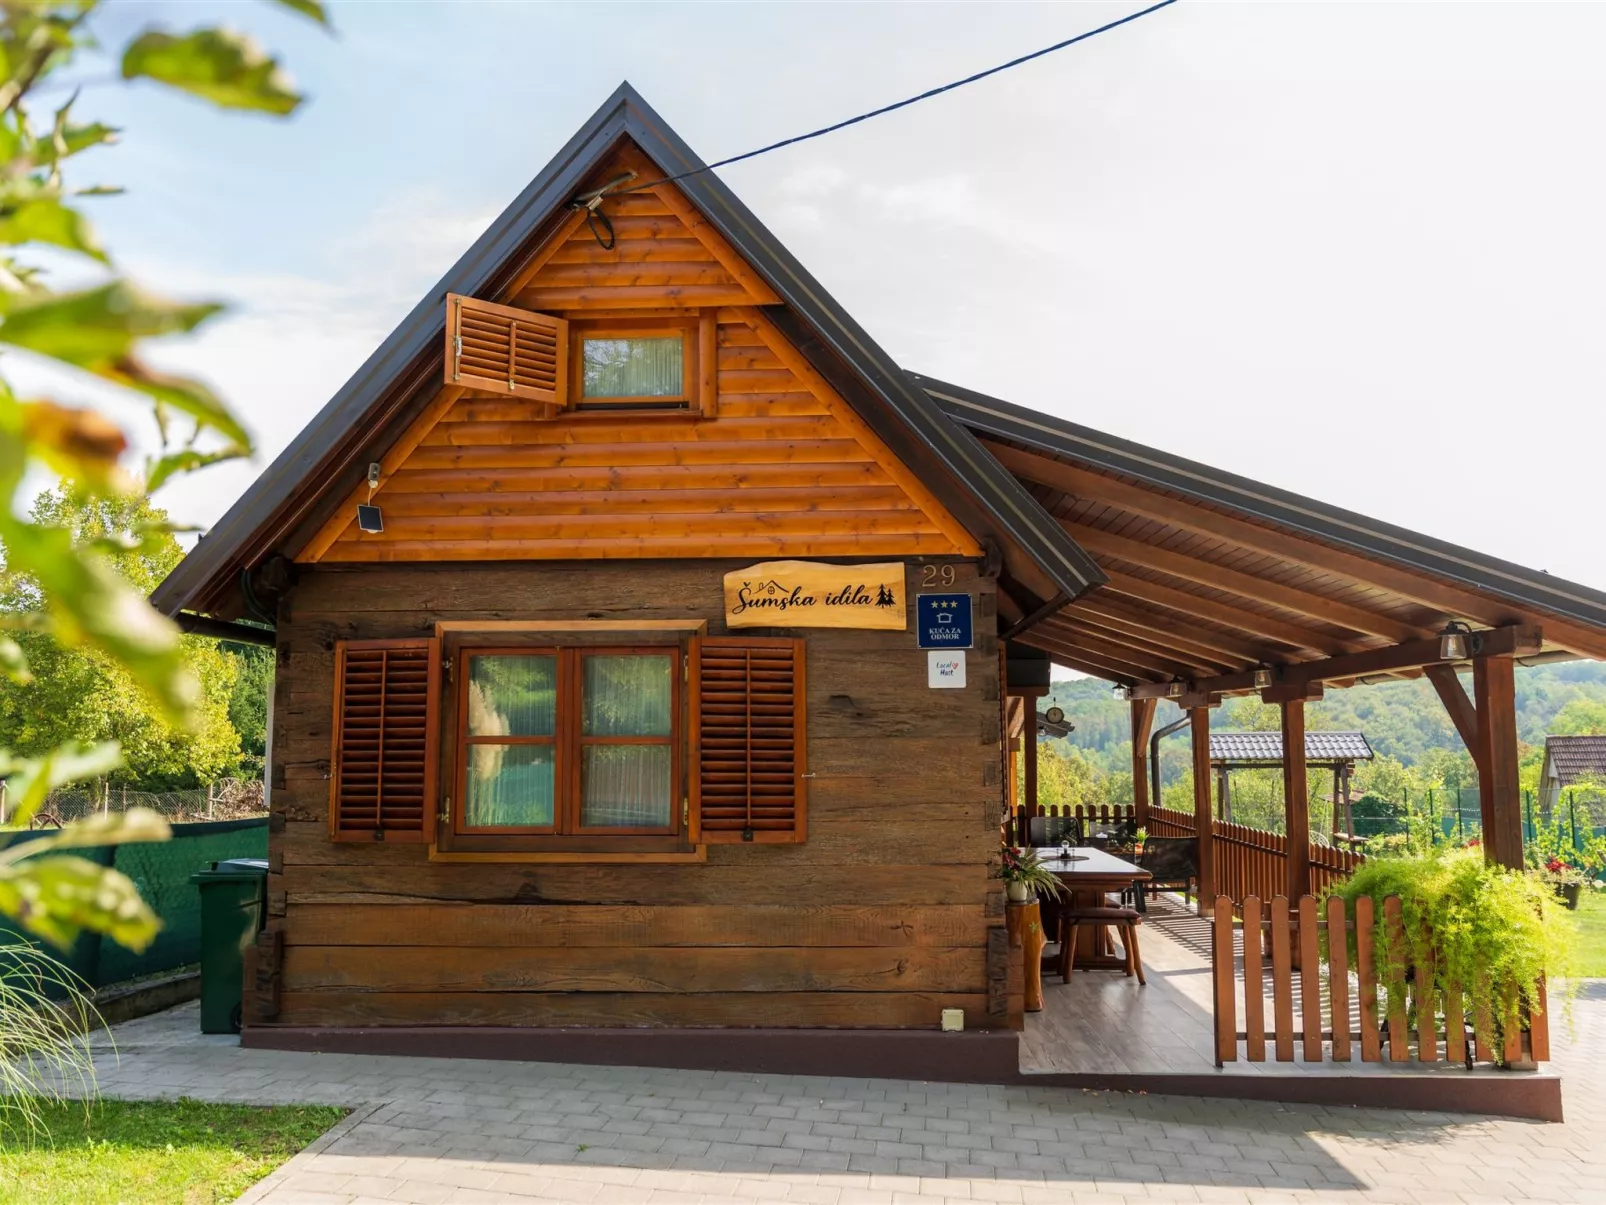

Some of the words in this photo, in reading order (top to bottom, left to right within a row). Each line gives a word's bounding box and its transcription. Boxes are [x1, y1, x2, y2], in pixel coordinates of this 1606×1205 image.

[922, 564, 956, 587] 29
[731, 581, 816, 614] Šumska
[825, 584, 873, 606] idila
[936, 661, 952, 669] Local
